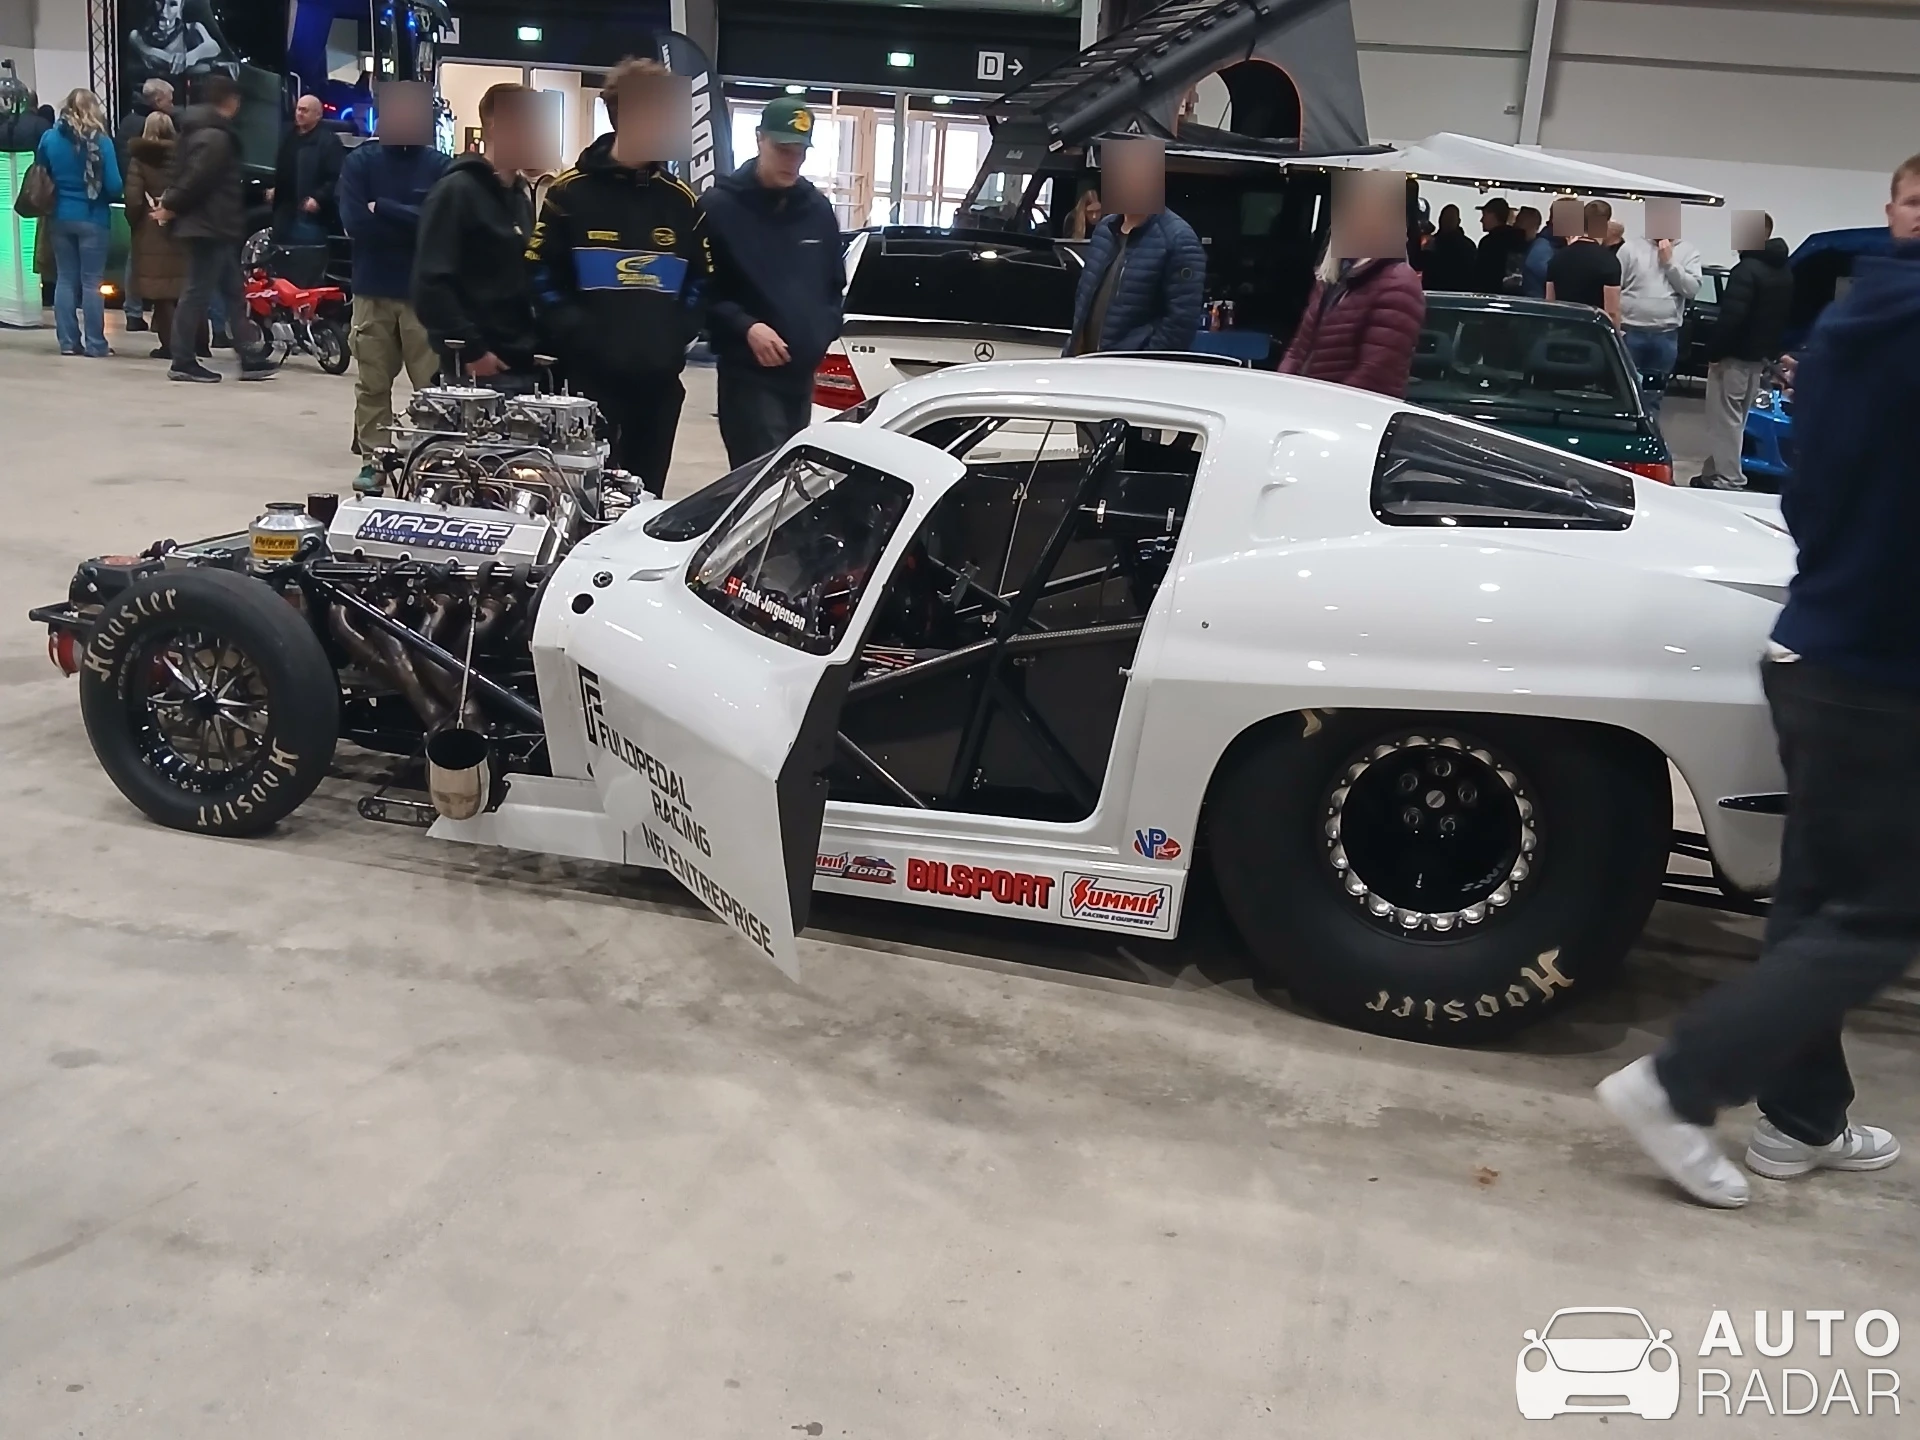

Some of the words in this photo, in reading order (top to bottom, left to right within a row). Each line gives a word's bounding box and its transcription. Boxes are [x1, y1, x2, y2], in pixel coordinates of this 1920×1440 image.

[983, 55, 999, 76] D
[365, 511, 512, 540] MADCAP
[357, 531, 416, 544] RACING
[427, 539, 499, 553] ENGINES
[737, 581, 761, 608] Frank
[598, 719, 693, 813] FULDPEDAL
[1135, 827, 1168, 860] VP
[907, 858, 1056, 910] BILSPORT
[1081, 911, 1110, 921] RACING
[1110, 914, 1155, 927] EQUIPMENT
[1365, 945, 1576, 1022] Hoosier
